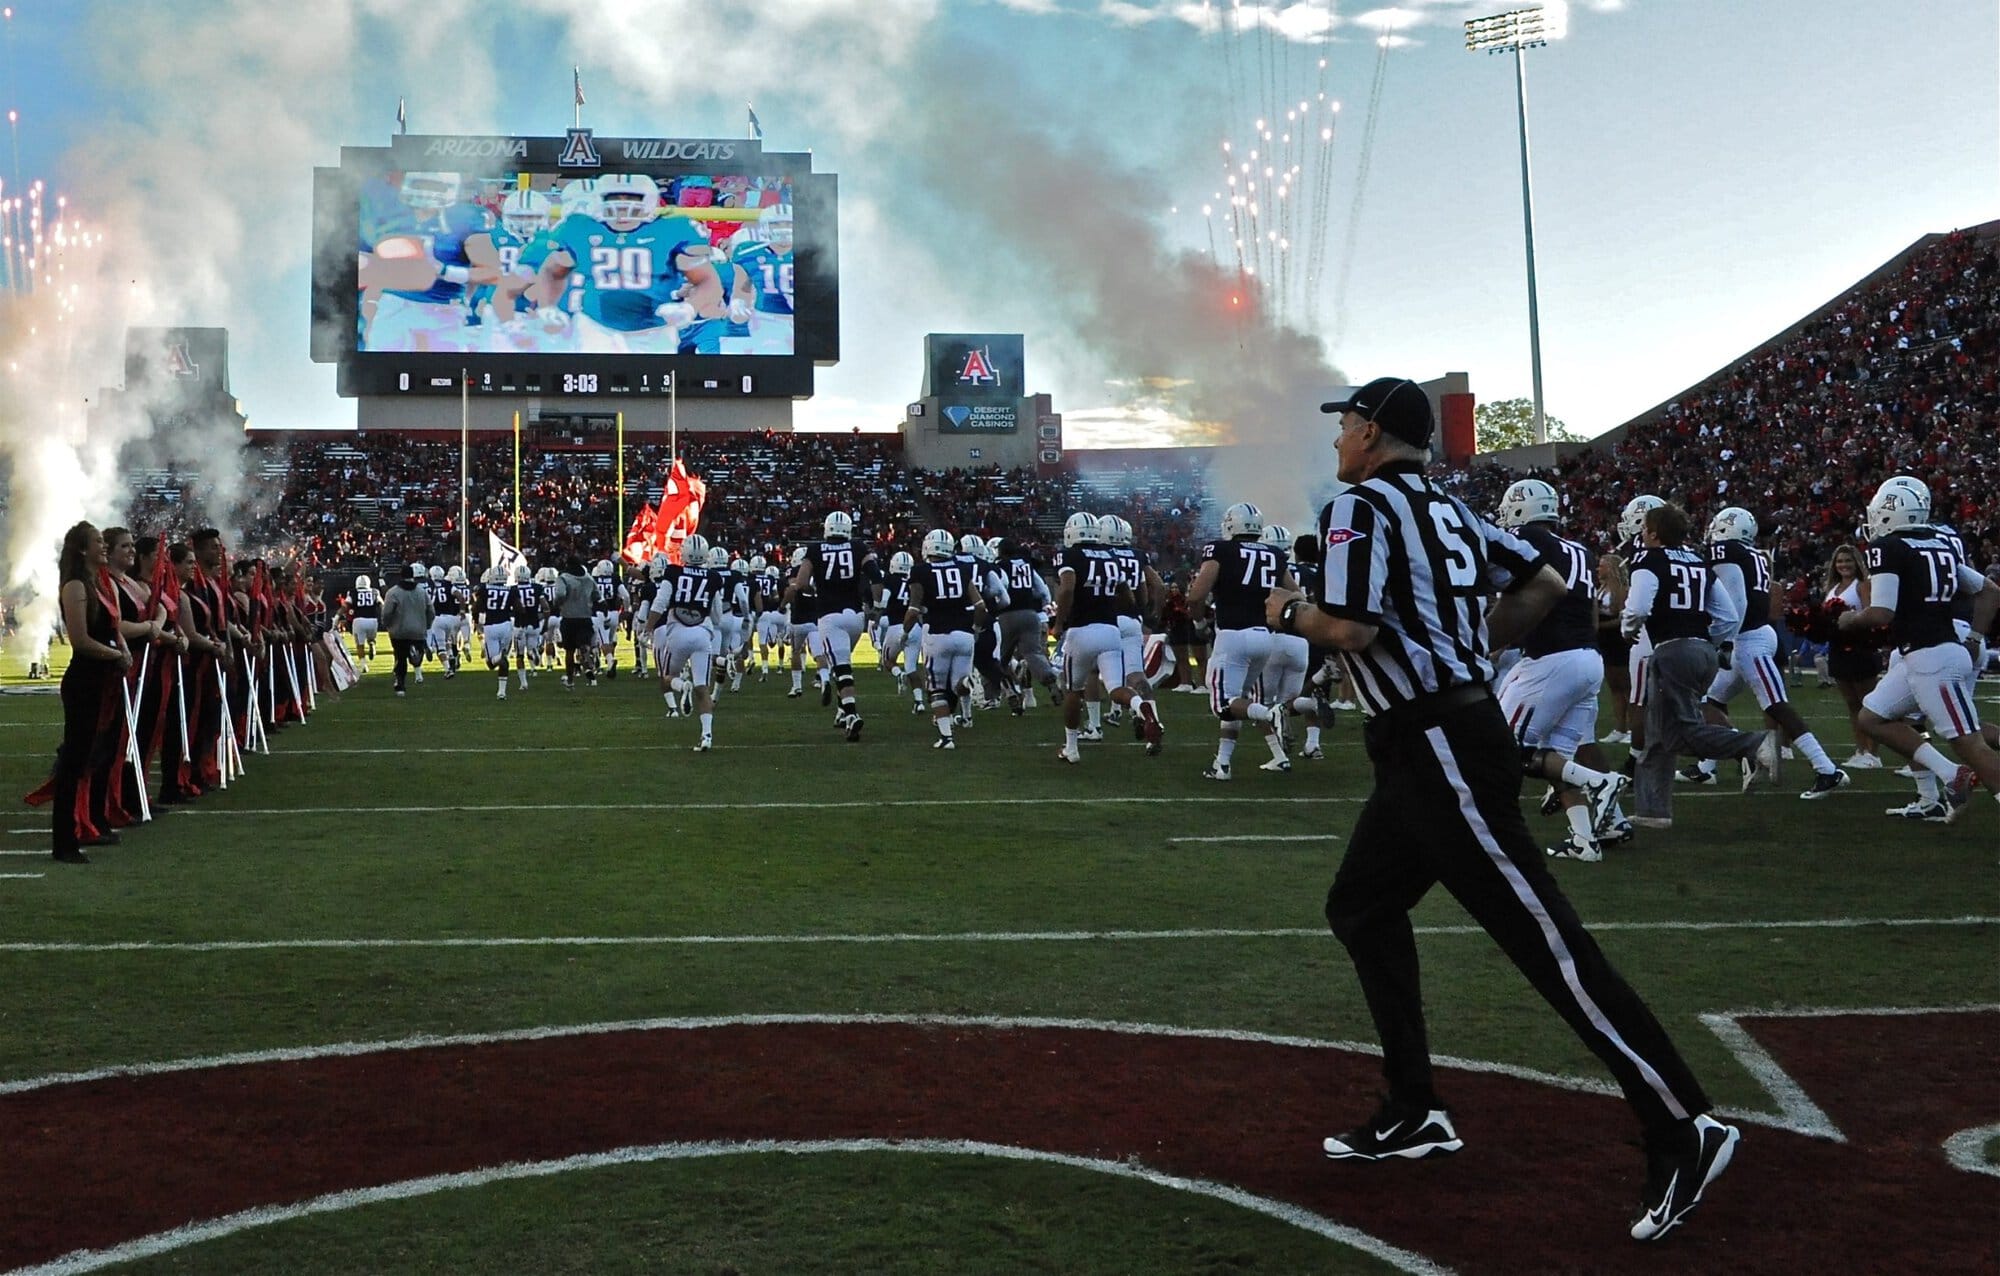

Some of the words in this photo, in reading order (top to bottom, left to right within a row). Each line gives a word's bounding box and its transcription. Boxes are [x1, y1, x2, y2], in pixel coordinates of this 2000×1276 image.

[424, 140, 528, 157] ARIZONA
[558, 128, 600, 167] A
[621, 140, 736, 161] WILDCATS
[591, 246, 652, 290] 20
[563, 374, 598, 393] 3:03
[642, 374, 648, 386] 1
[969, 413, 1016, 421] DIAMOND
[973, 406, 1011, 414] DESERT
[970, 420, 1014, 428] CASINOS
[574, 437, 584, 445] 12
[1427, 501, 1477, 586] S
[1710, 546, 1726, 560] 15
[822, 550, 854, 580] 79
[1240, 548, 1277, 588] 72
[1865, 548, 1881, 568] 13
[1083, 560, 1119, 596] 48
[1559, 540, 1594, 599] 74
[1750, 552, 1771, 594] 15
[1919, 551, 1958, 602] 13
[675, 576, 709, 609] 84
[931, 567, 963, 599] 19
[1670, 563, 1707, 612] 37
[357, 591, 374, 607] 99
[486, 589, 510, 610] 27
[519, 588, 536, 607] 15
